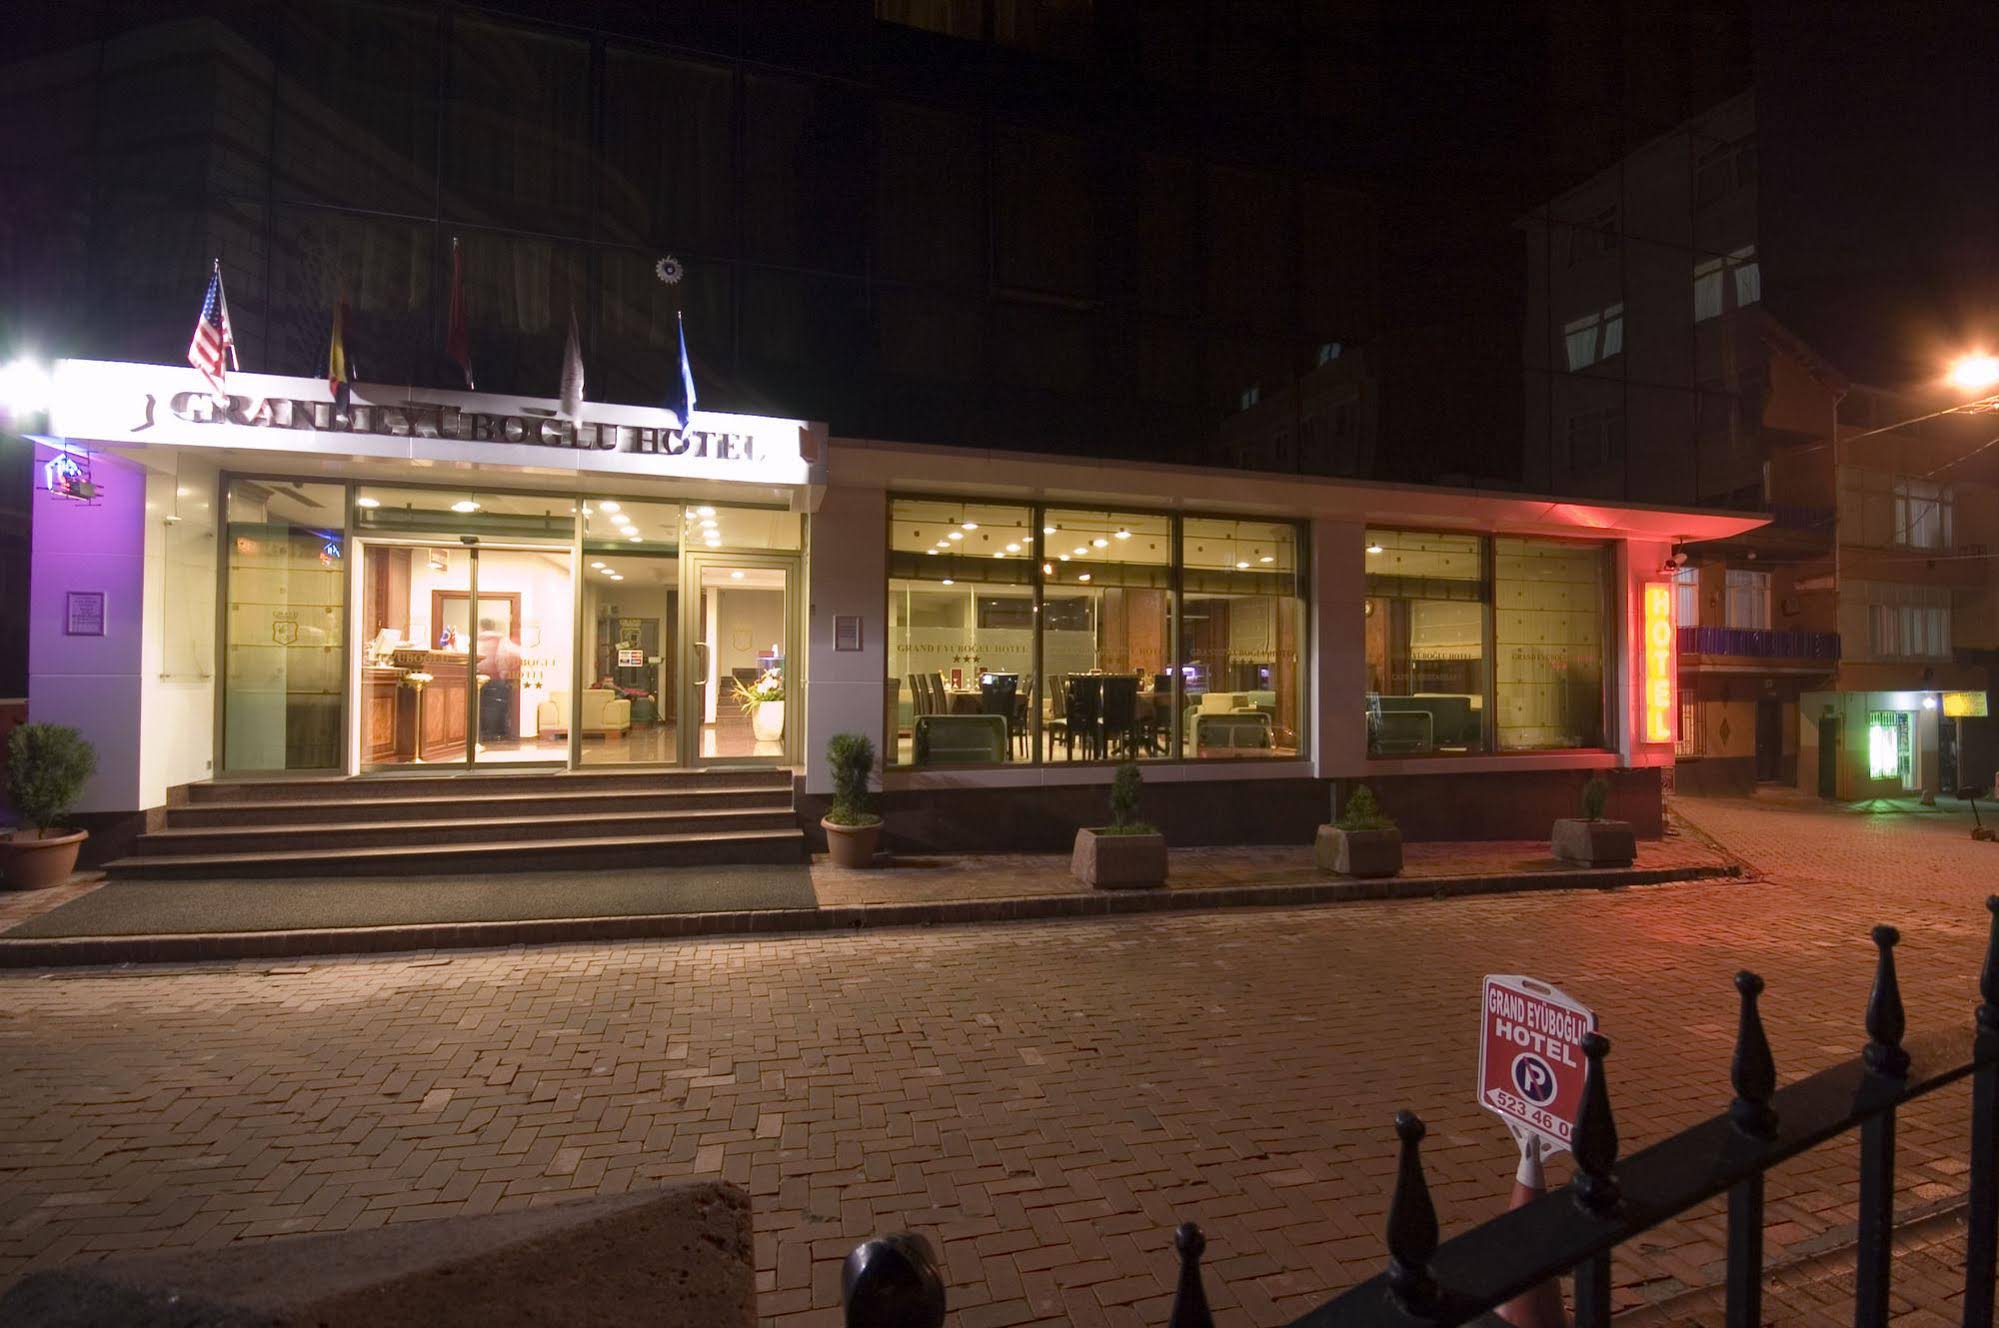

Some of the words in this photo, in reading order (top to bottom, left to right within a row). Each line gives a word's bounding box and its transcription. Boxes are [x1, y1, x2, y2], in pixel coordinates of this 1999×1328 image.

[1652, 590, 1671, 738] HOTEL
[1489, 987, 1524, 1023] GRAND
[1496, 1017, 1577, 1068] HOTEL
[1498, 1092, 1526, 1116] 523
[1532, 1110, 1552, 1129] 46
[1559, 1122, 1573, 1138] 0
